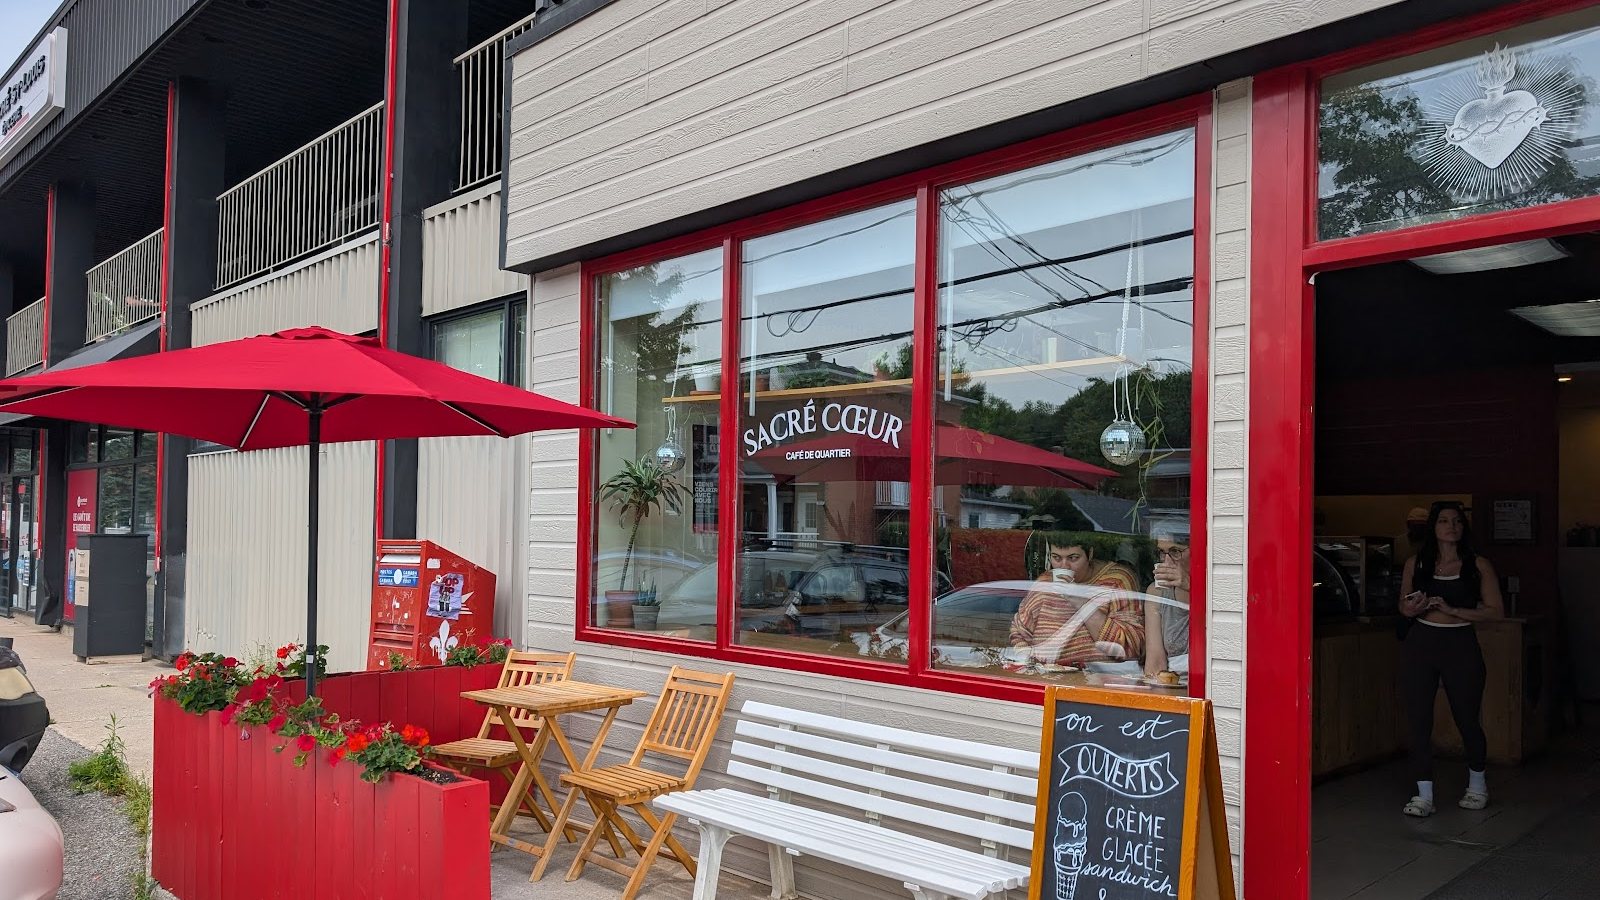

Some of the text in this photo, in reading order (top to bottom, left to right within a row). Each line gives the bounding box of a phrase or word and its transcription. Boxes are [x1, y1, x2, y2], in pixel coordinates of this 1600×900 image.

[743, 398, 903, 456] SACRÉ CŒUR
[786, 448, 851, 461] CAFÉ DE QUARTIER
[1056, 713, 1189, 740] on est
[1077, 745, 1164, 794] OUVERTS
[1105, 804, 1166, 839] CRÈME
[1102, 836, 1165, 874] GLACÉE
[1081, 862, 1178, 897] sandwich
